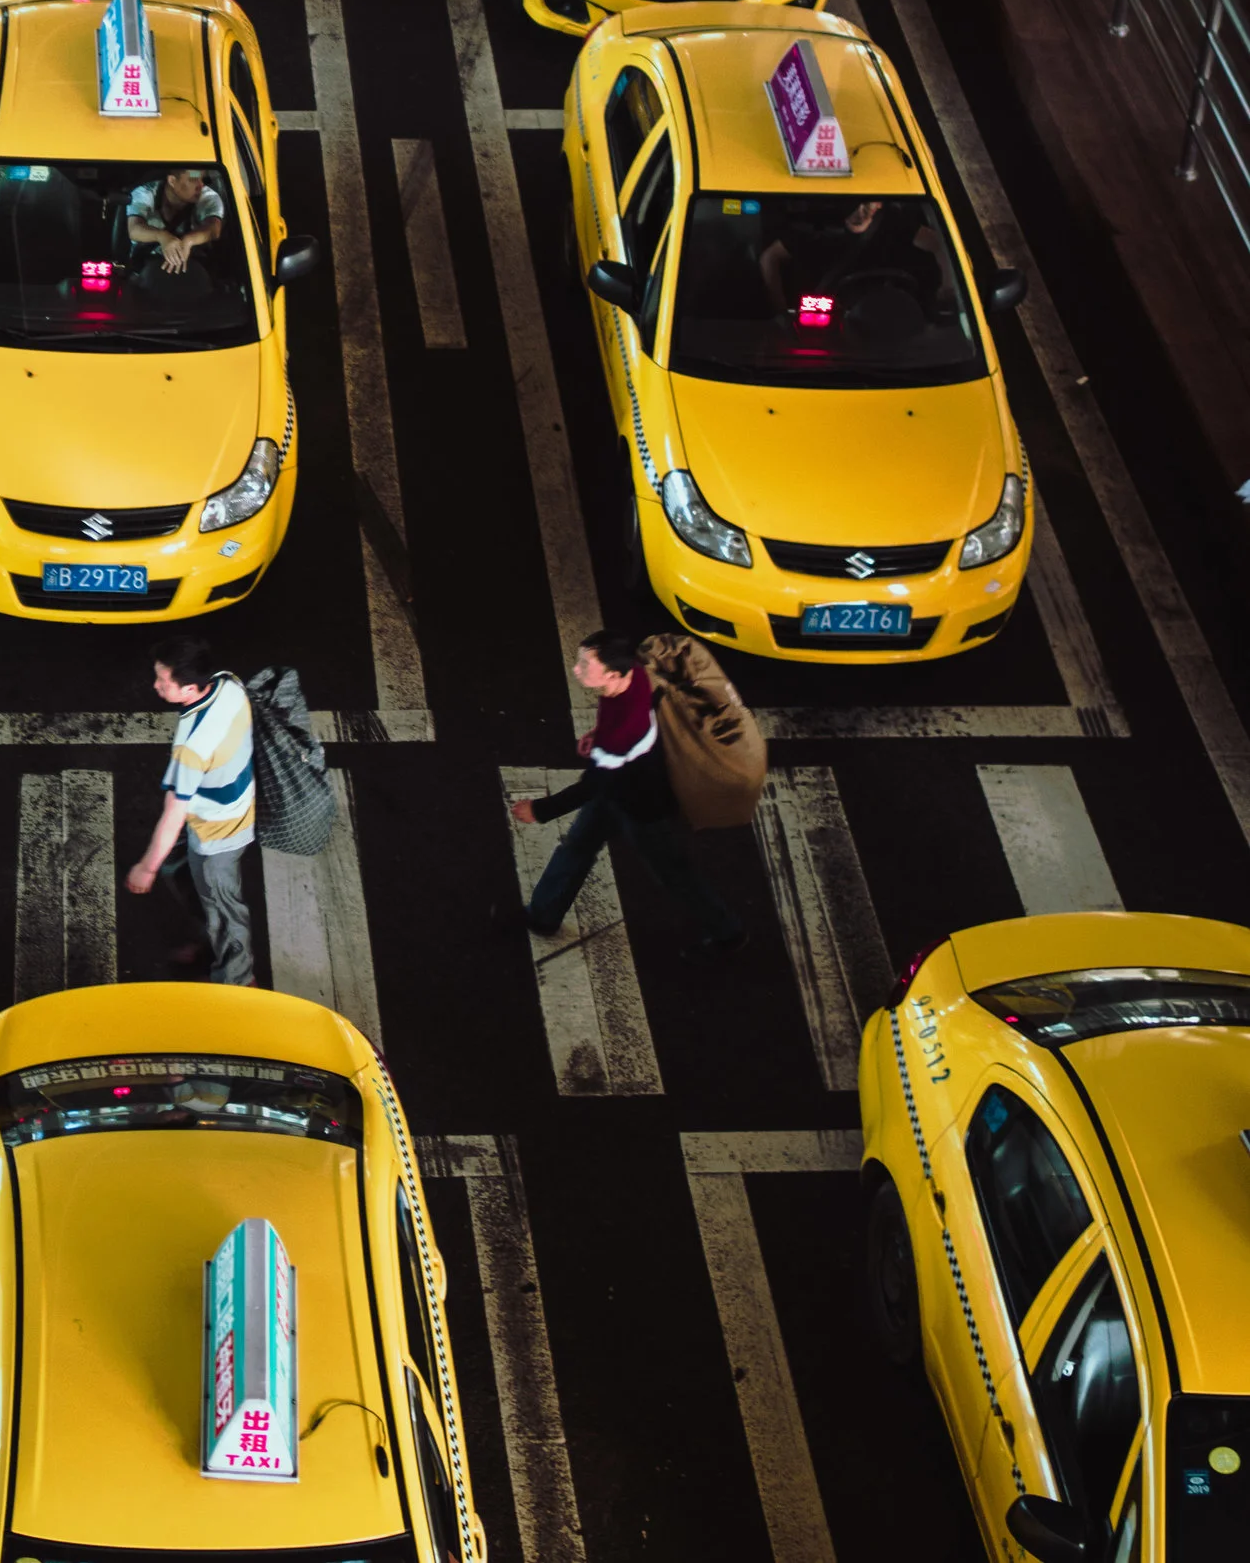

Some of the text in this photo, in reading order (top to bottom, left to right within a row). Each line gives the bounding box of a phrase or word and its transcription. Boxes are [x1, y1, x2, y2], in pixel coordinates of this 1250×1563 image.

[123, 64, 141, 96] 出租
[114, 98, 149, 108] TAXI
[816, 125, 835, 156] 出租
[806, 158, 842, 169] TAXI
[82, 261, 112, 277] 空车
[801, 296, 834, 312] 空车
[910, 993, 952, 1086] 970512
[240, 1410, 270, 1453] 出租
[226, 1454, 280, 1469] TAXI
